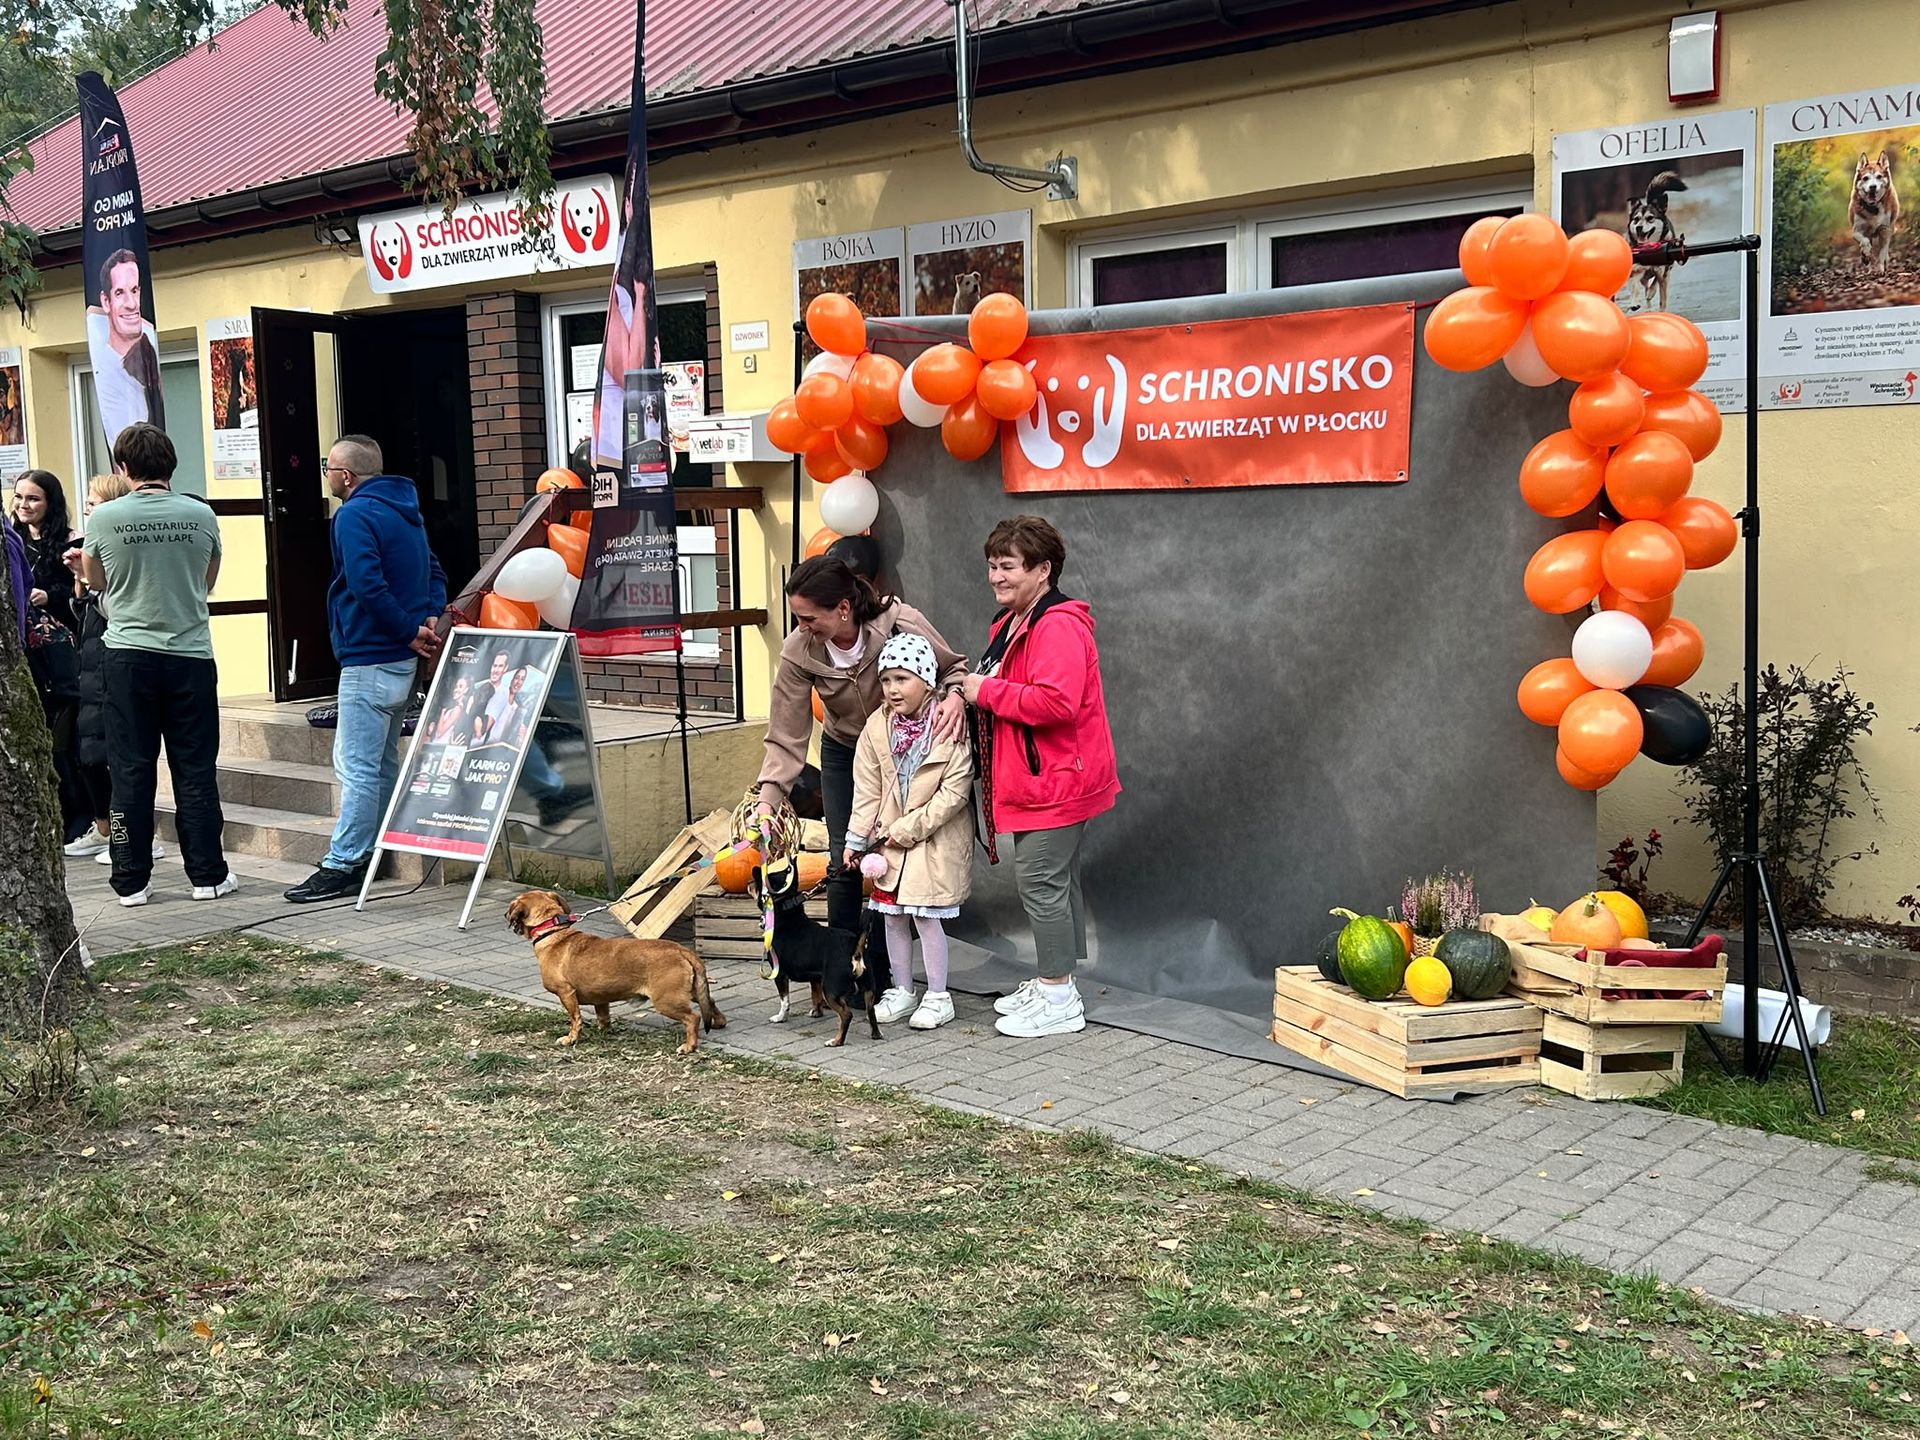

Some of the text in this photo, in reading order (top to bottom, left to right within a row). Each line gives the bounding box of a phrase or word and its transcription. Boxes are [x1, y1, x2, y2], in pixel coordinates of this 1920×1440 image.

[1600, 122, 1708, 159] OFELIA
[942, 219, 996, 245] HYZIO
[822, 236, 875, 260] BÓJKA
[422, 254, 442, 269] DLA
[443, 246, 495, 266] ZWIERZĄT
[497, 244, 509, 258] W
[224, 320, 249, 335] SARA
[1815, 327, 1843, 335] Cynamon
[735, 330, 764, 342] DZWONEK
[1137, 354, 1394, 405] SCHRONISKO
[1136, 409, 1388, 442] DLA ZWIERZĄT W PŁOCKU
[113, 522, 199, 534] WOLONTARIUSZ
[123, 533, 194, 545] ŁAPA W ŁAPĘ
[469, 759, 511, 772] KARM GO
[465, 772, 484, 783] JAK
